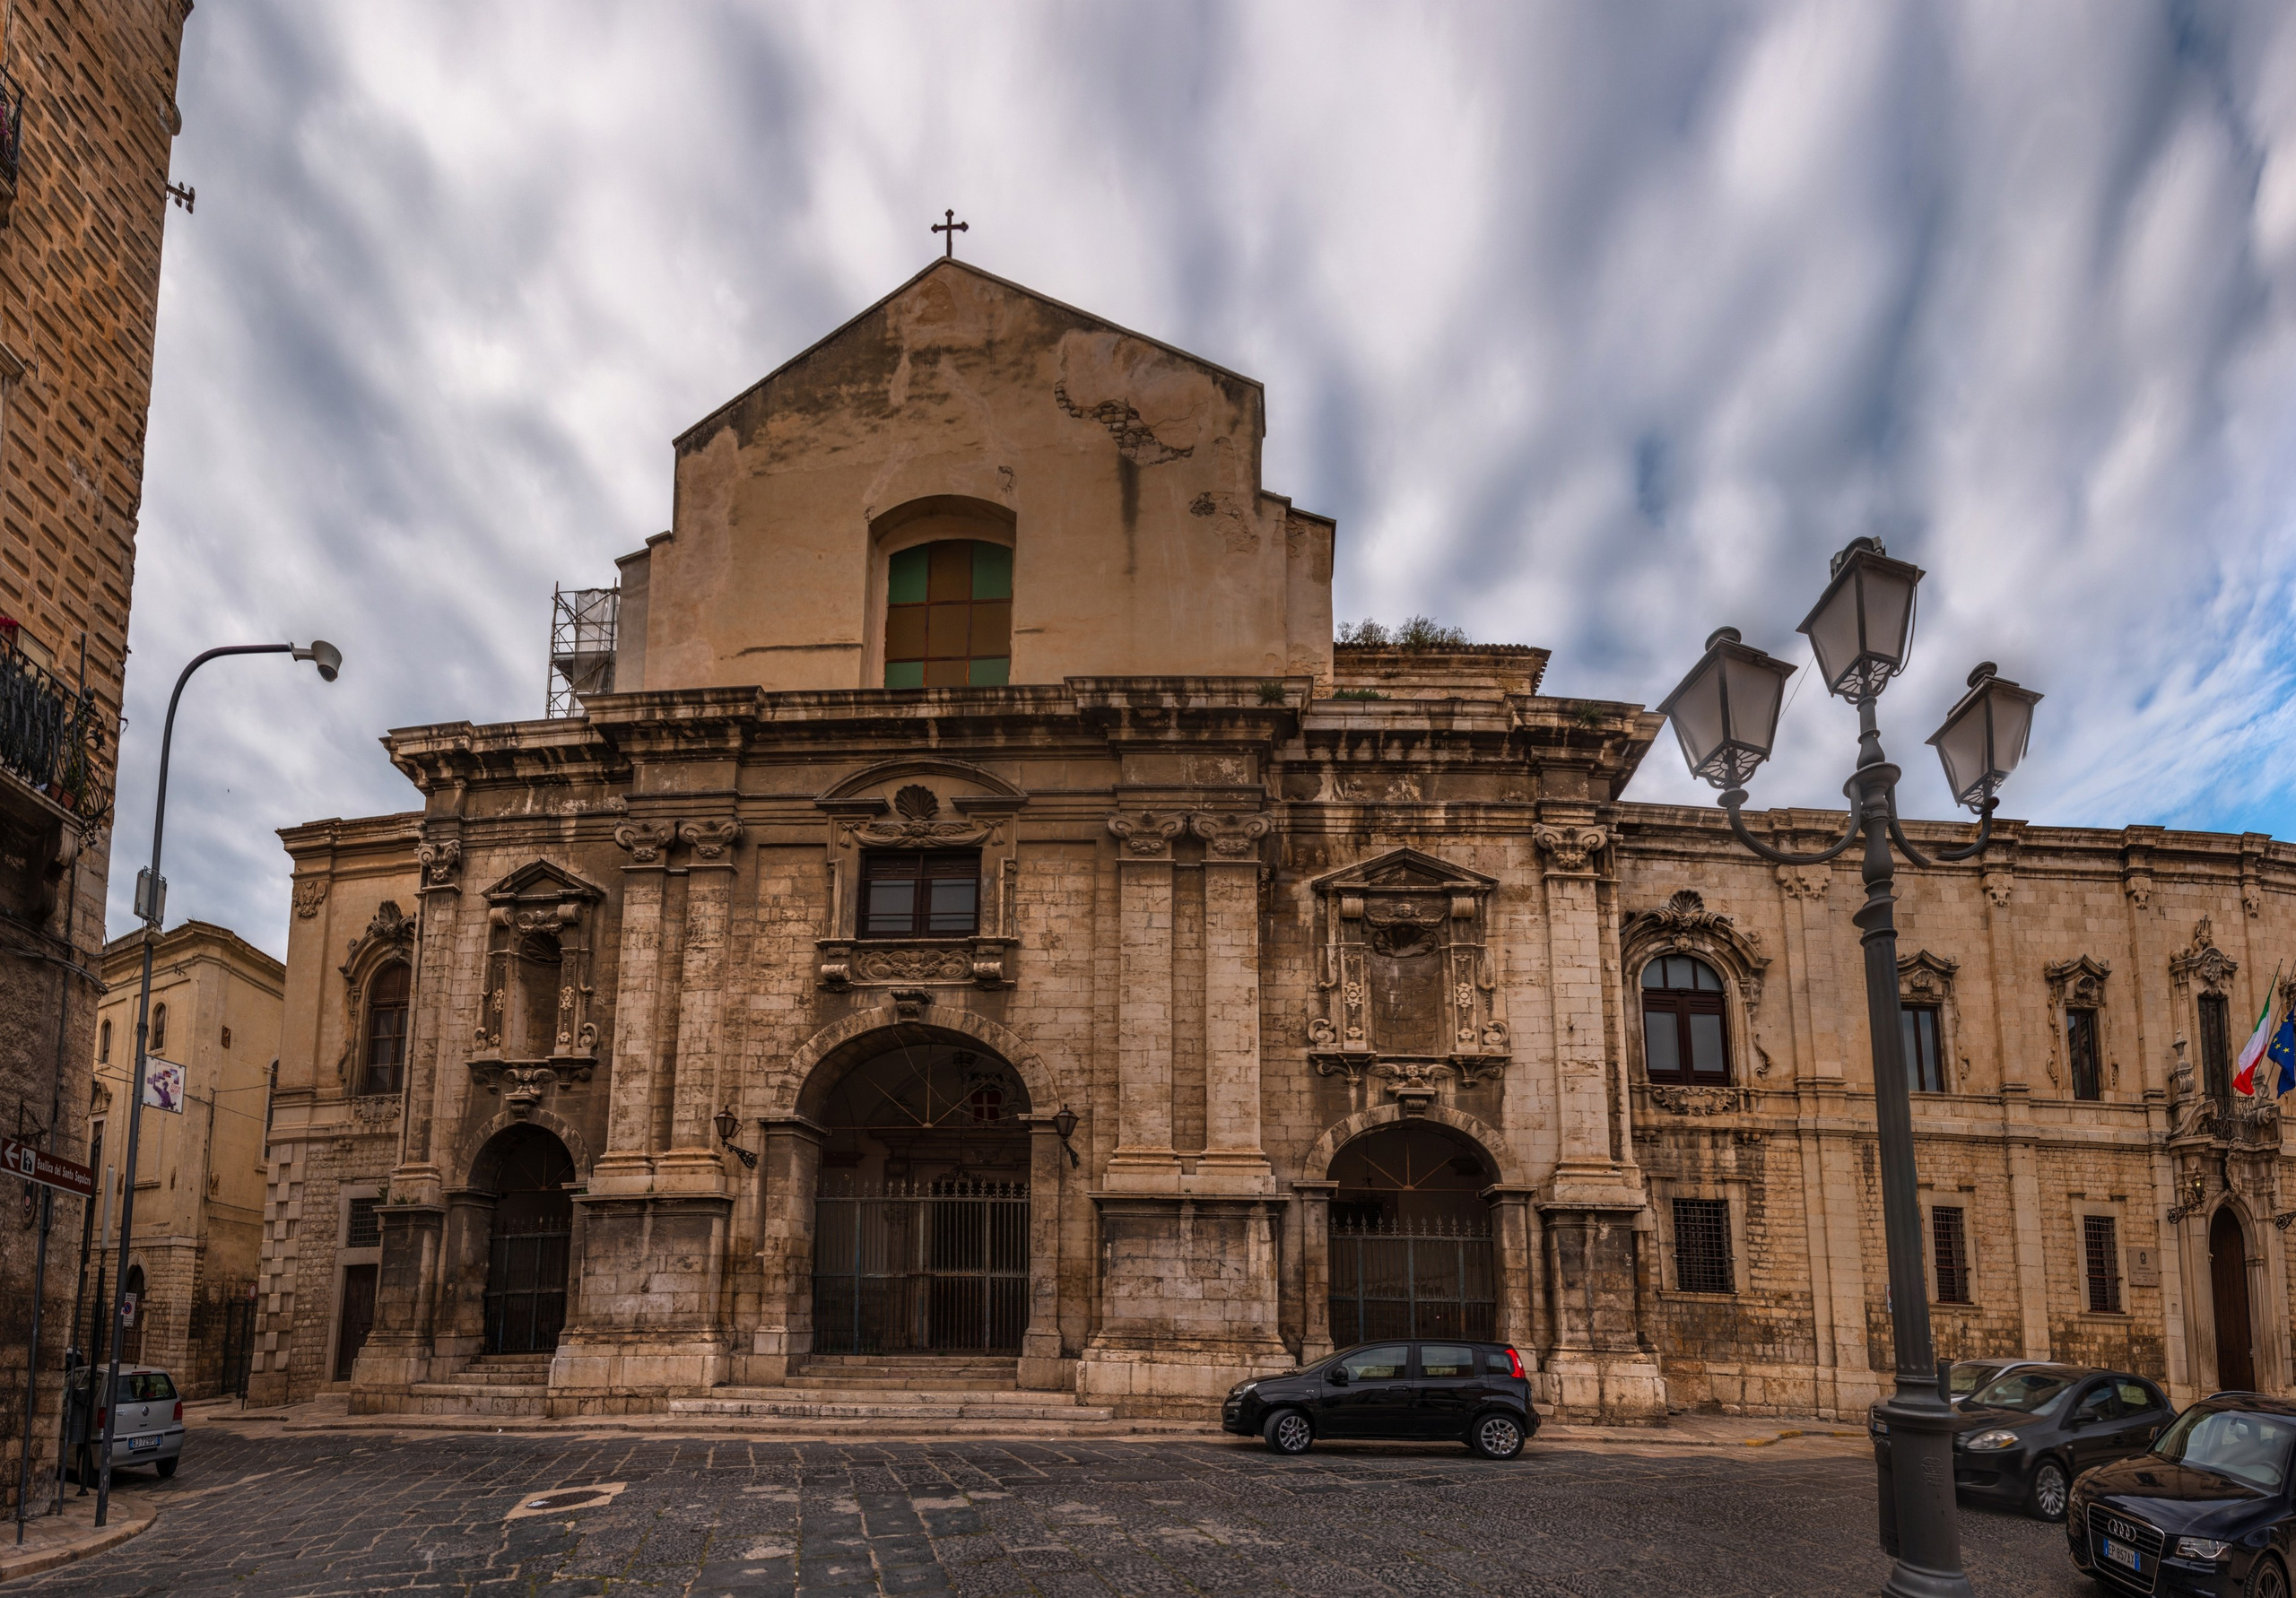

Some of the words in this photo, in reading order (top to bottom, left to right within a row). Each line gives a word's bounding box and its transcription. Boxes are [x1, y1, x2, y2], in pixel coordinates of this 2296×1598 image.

[37, 1158, 54, 1174] Basilica
[54, 1163, 62, 1177] del
[62, 1166, 74, 1180] Santo
[74, 1170, 91, 1185] Sepolcro
[2109, 1543, 2116, 1556] EP
[2117, 1547, 2135, 1566] 857AX
